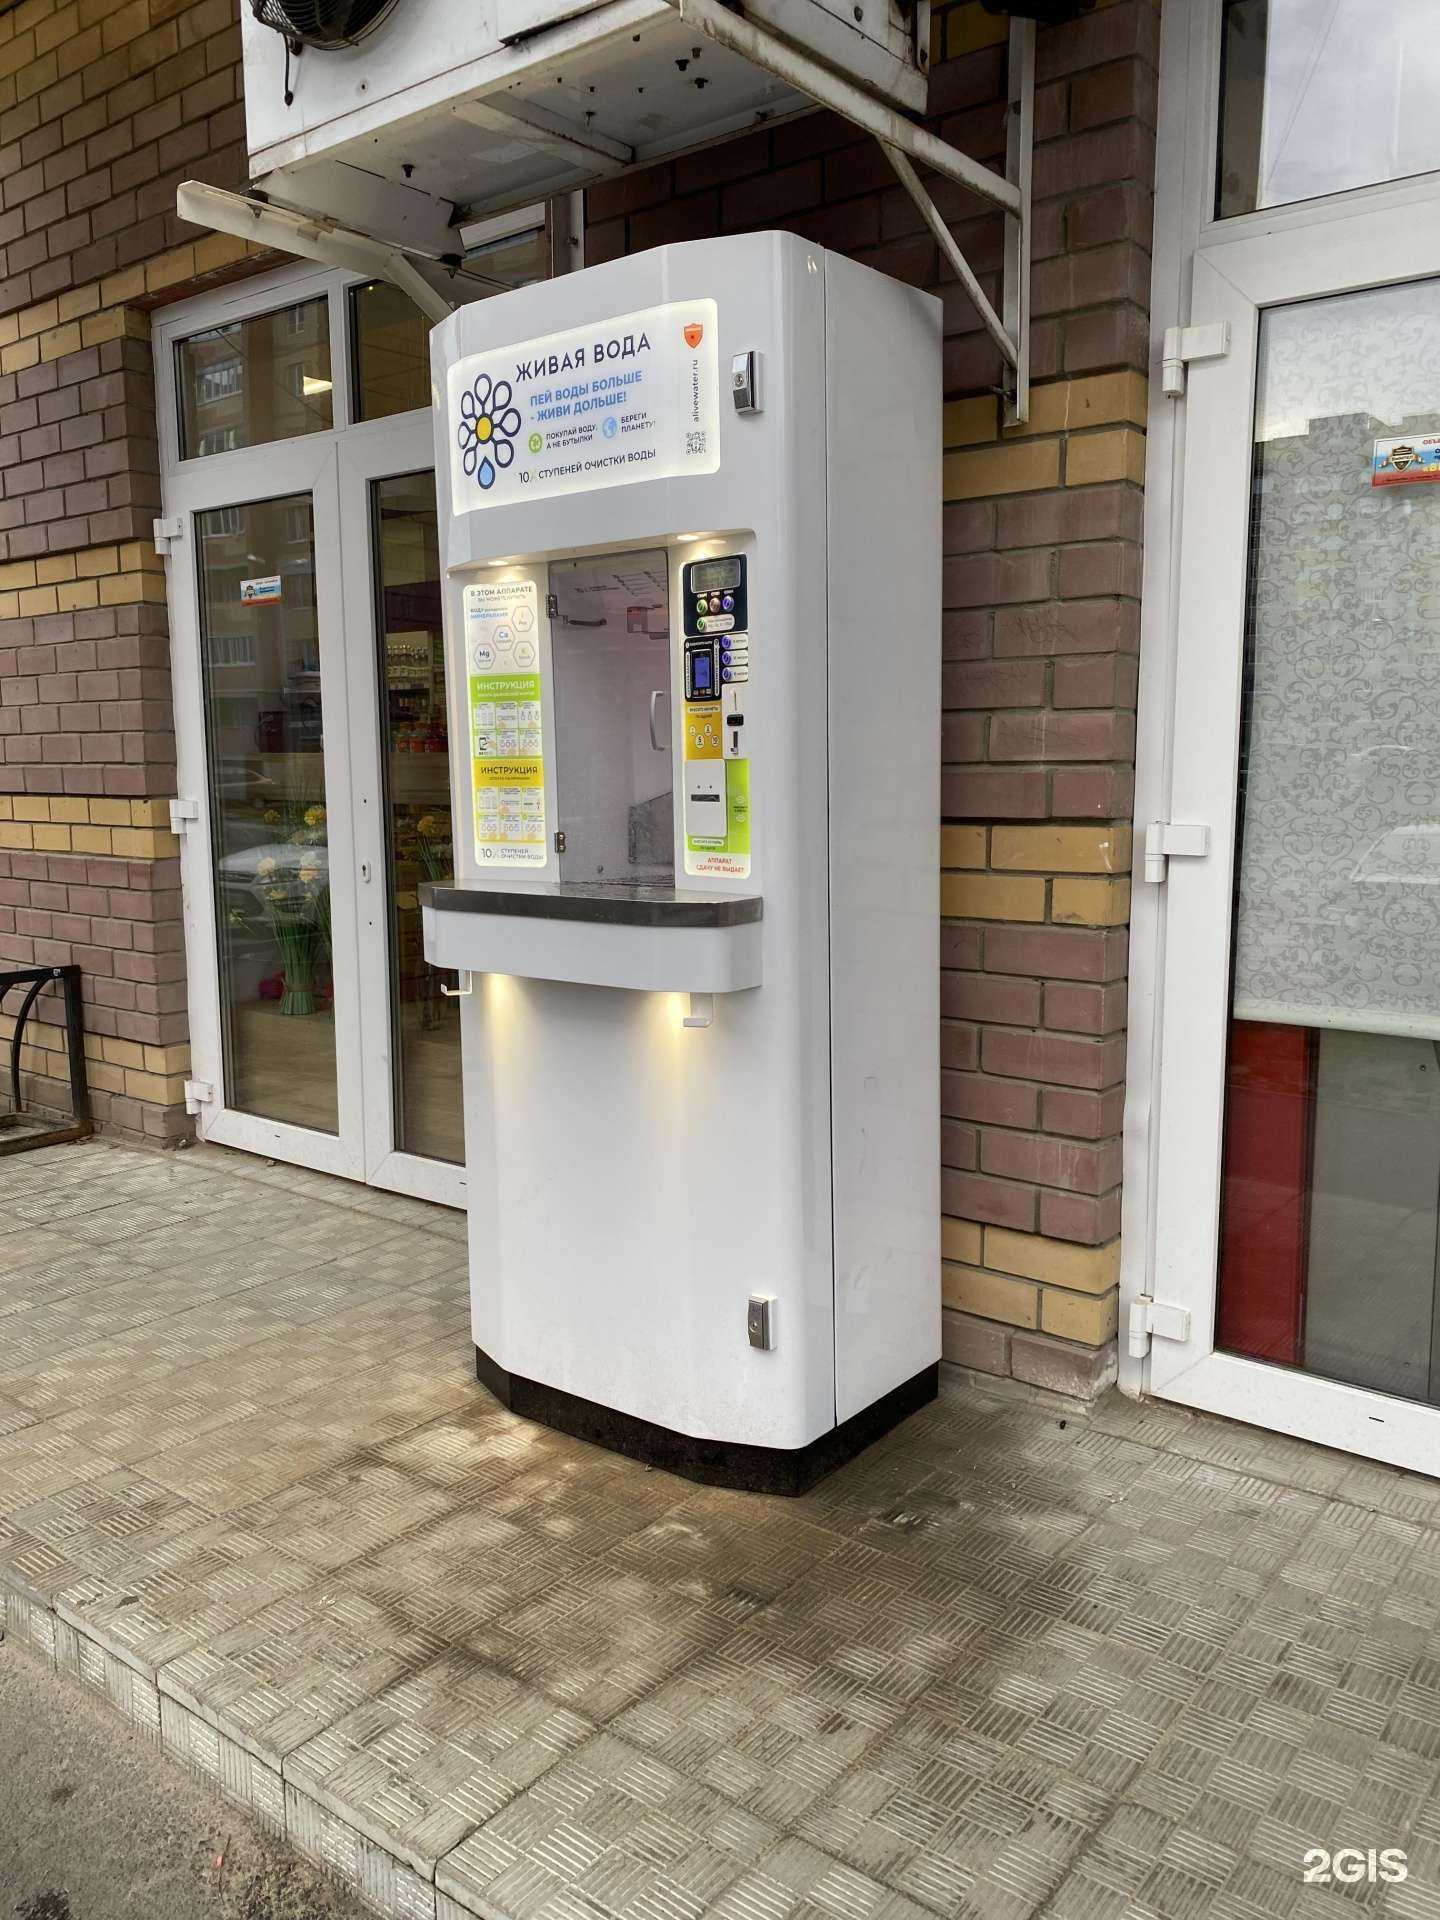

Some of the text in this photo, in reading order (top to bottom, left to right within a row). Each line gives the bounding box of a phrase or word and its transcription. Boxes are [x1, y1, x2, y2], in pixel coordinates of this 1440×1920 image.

[516, 332, 651, 382] ЖИВАЯ ВОДА
[530, 370, 643, 407] ПЕЙ ВОДЫ БОЛЬШЕ
[692, 359, 700, 422] alivewater.ru
[537, 404, 571, 421] ЖИВИ
[573, 391, 627, 416] ДОЛЬШЕ!
[620, 412, 647, 424] БЕРЕГИ
[546, 427, 577, 440] ПОКУПАЙ
[552, 440, 561, 448] НЕ
[562, 434, 593, 446] БУТЫЛКИ
[538, 460, 583, 479] СТУПЕНЕЙ
[584, 456, 626, 471] ОЧИСТКИ
[627, 449, 657, 462] ВОДЫ
[478, 588, 495, 596] ЭТОМ
[479, 650, 490, 658] Mg
[477, 680, 535, 691] ИНСТРУКЦИЯ
[481, 766, 538, 775] ИНСТРУКЦИЯ
